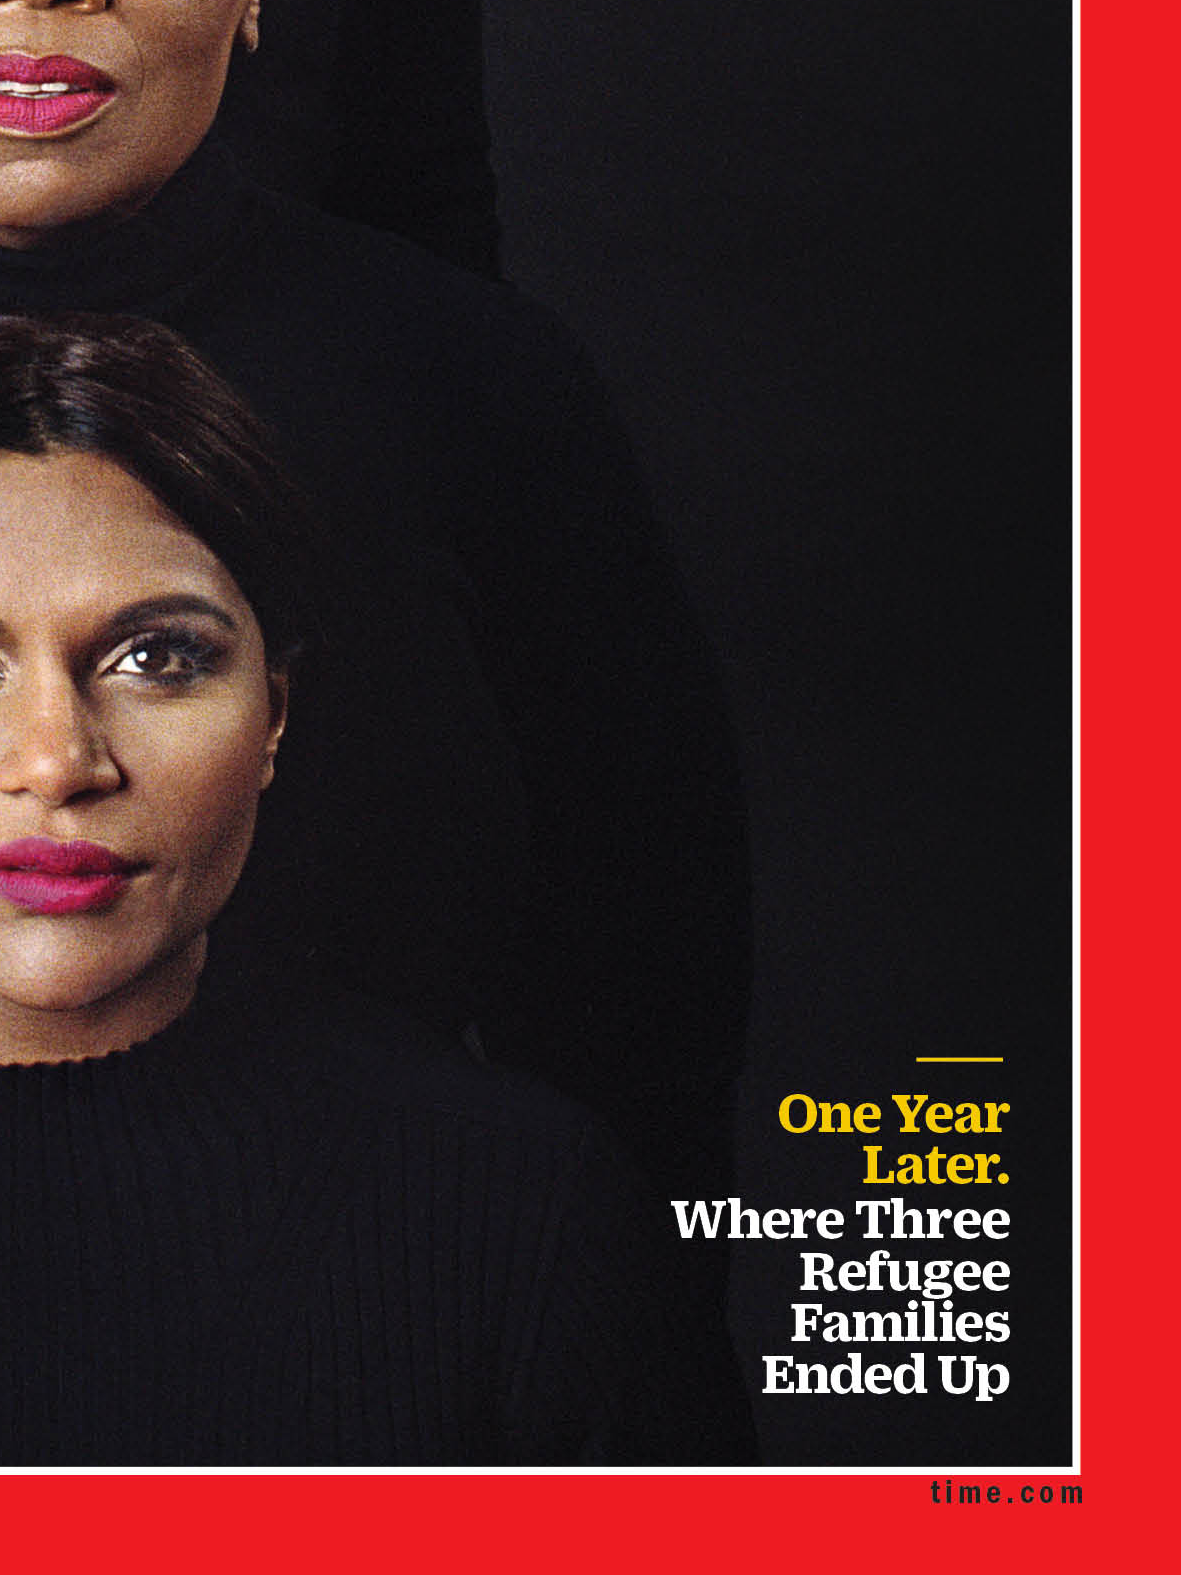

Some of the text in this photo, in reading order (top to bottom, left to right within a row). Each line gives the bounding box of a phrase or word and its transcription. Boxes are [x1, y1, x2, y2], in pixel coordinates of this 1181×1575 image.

[778, 1093, 1011, 1134] One Year
[862, 1145, 1010, 1185] Later.
[670, 1197, 1011, 1240] Where Three
[799, 1249, 1011, 1300] Refugee
[790, 1299, 1011, 1343] Families
[761, 1352, 1010, 1402] Ended Up
[930, 1479, 1083, 1504] time.com
